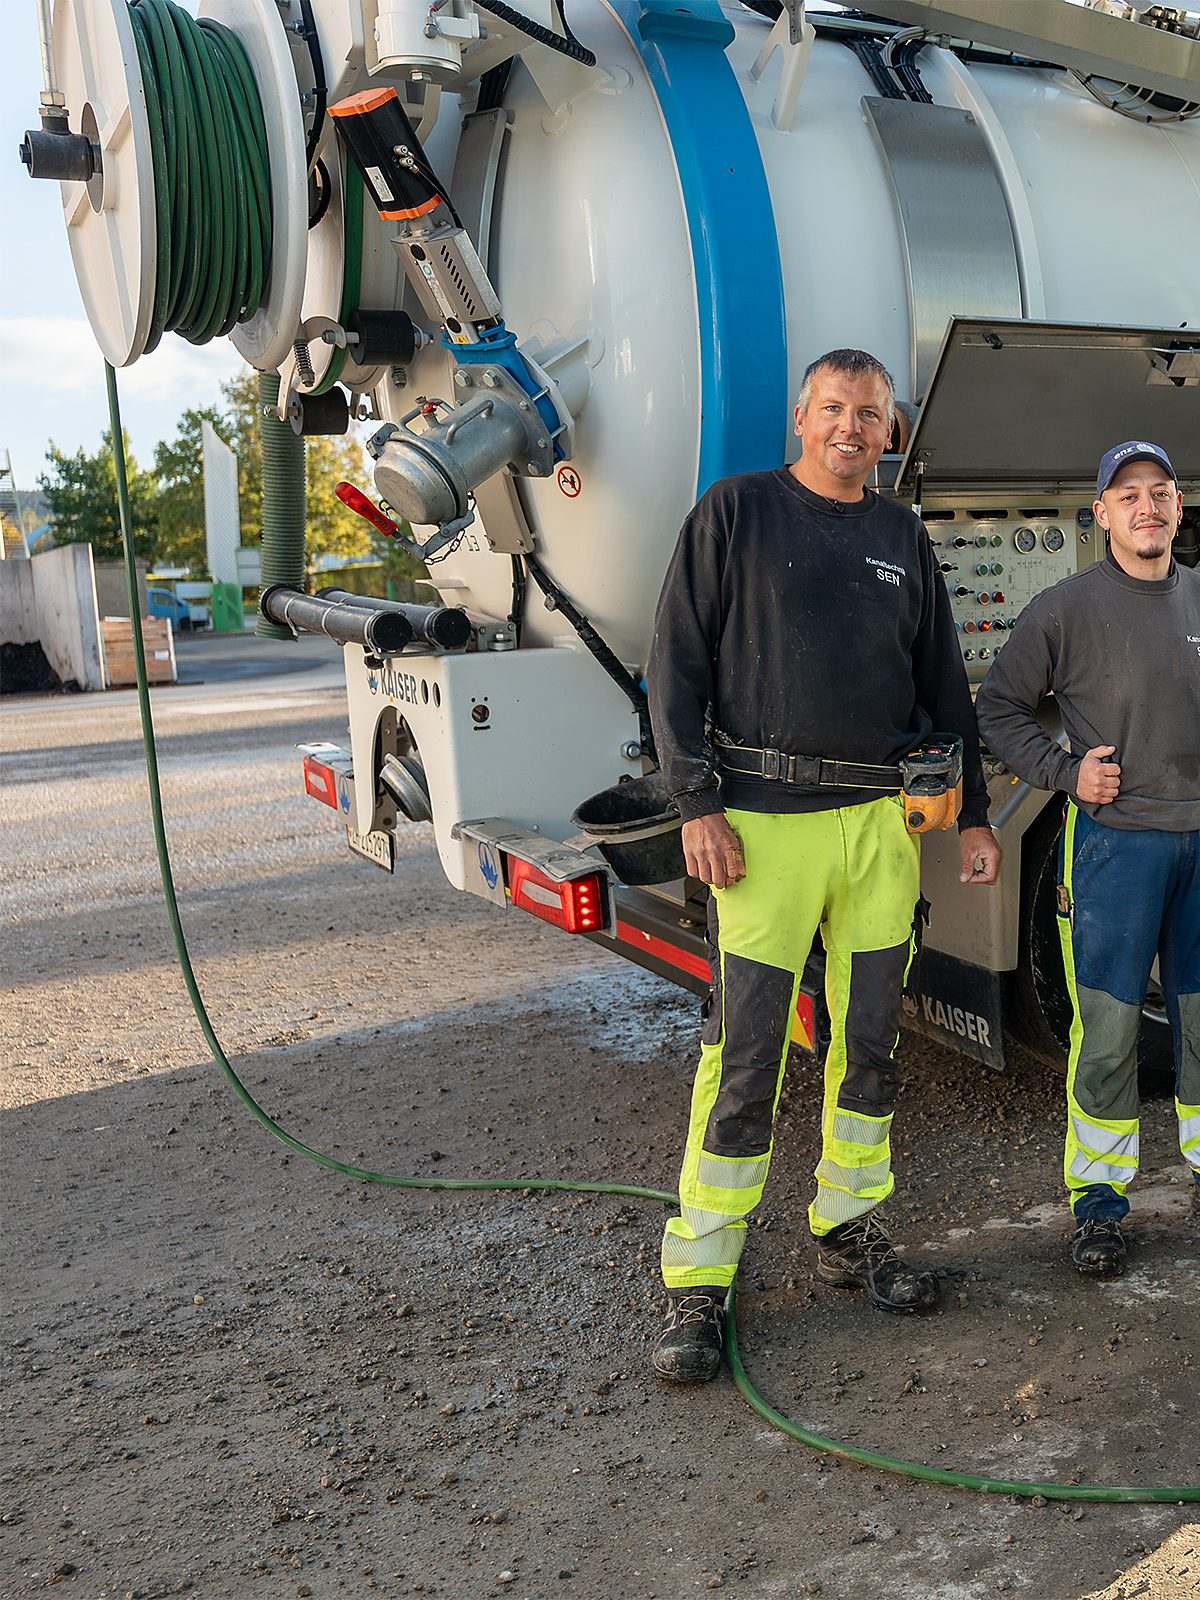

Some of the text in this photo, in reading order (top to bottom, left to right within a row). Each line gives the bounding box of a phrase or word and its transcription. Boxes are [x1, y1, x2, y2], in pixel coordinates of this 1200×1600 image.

[876, 568, 900, 587] SEN
[380, 668, 418, 705] KAISER
[921, 994, 992, 1049] KAISER
